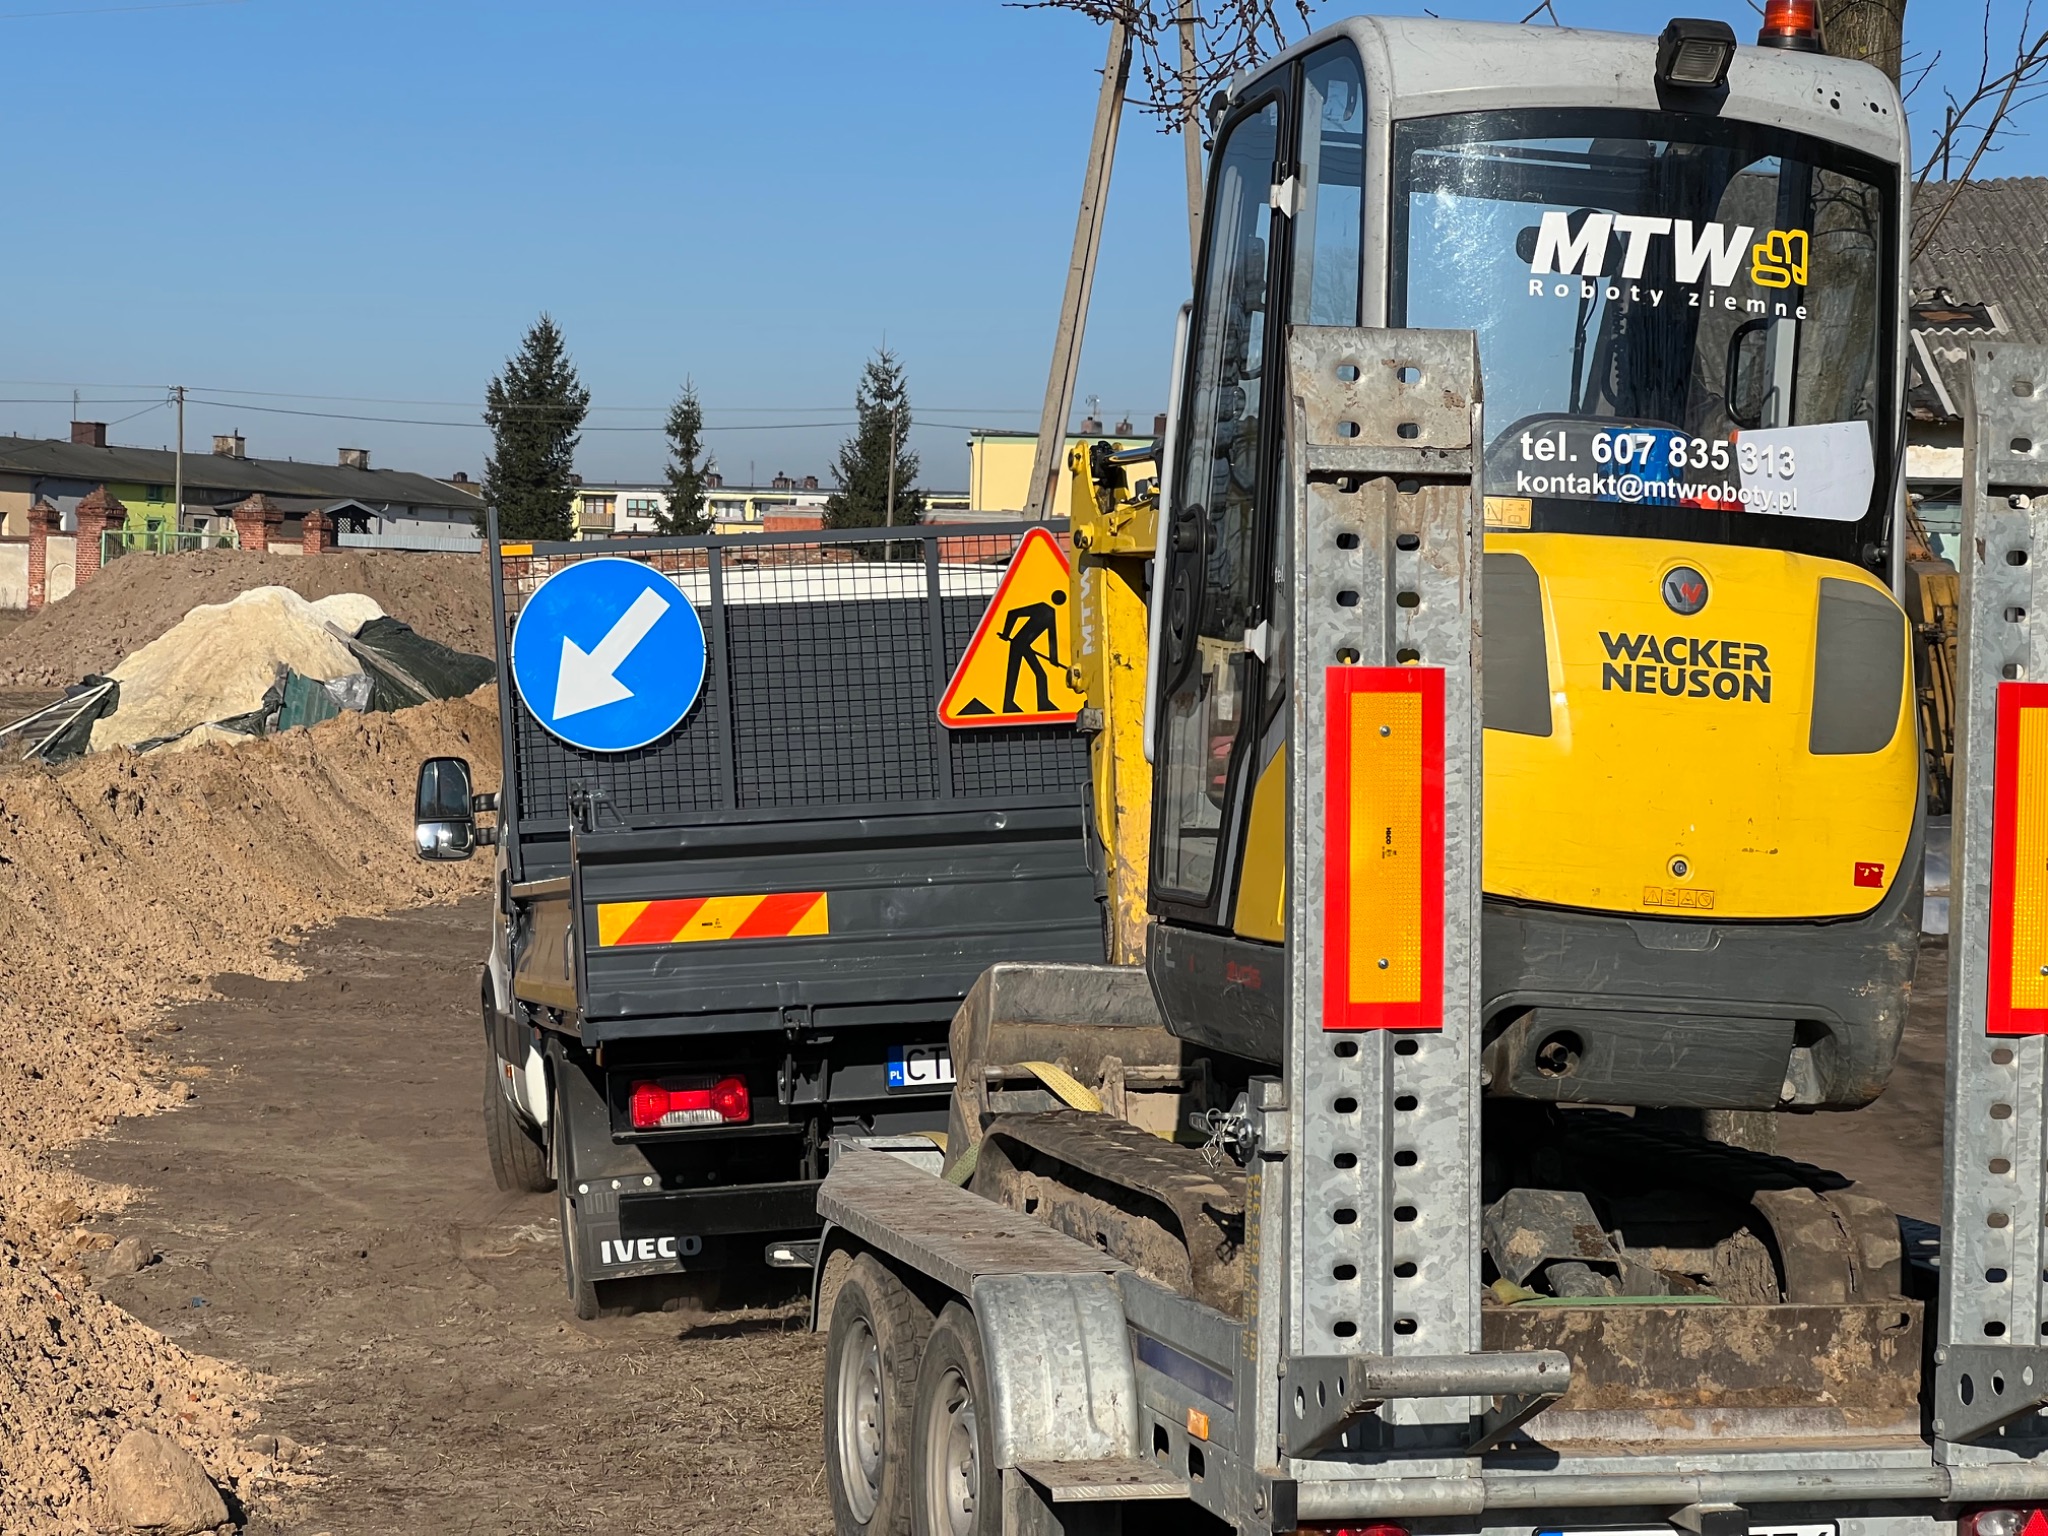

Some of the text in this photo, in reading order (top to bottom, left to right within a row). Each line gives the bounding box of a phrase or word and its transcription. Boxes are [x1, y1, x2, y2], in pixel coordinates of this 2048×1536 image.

[1530, 212, 1754, 287] MTW
[1528, 279, 1808, 319] Roboty ziemne
[1520, 432, 1796, 478] tel. 607 835 313
[1516, 470, 1799, 513] kontakt@mtwroboty.pl
[1598, 631, 1772, 673] WACKER
[1601, 662, 1772, 704] NEUSON
[890, 1070, 903, 1081] PL
[906, 1045, 956, 1082] CT
[1252, 1173, 1261, 1216] 313
[601, 1235, 702, 1265] IVECO
